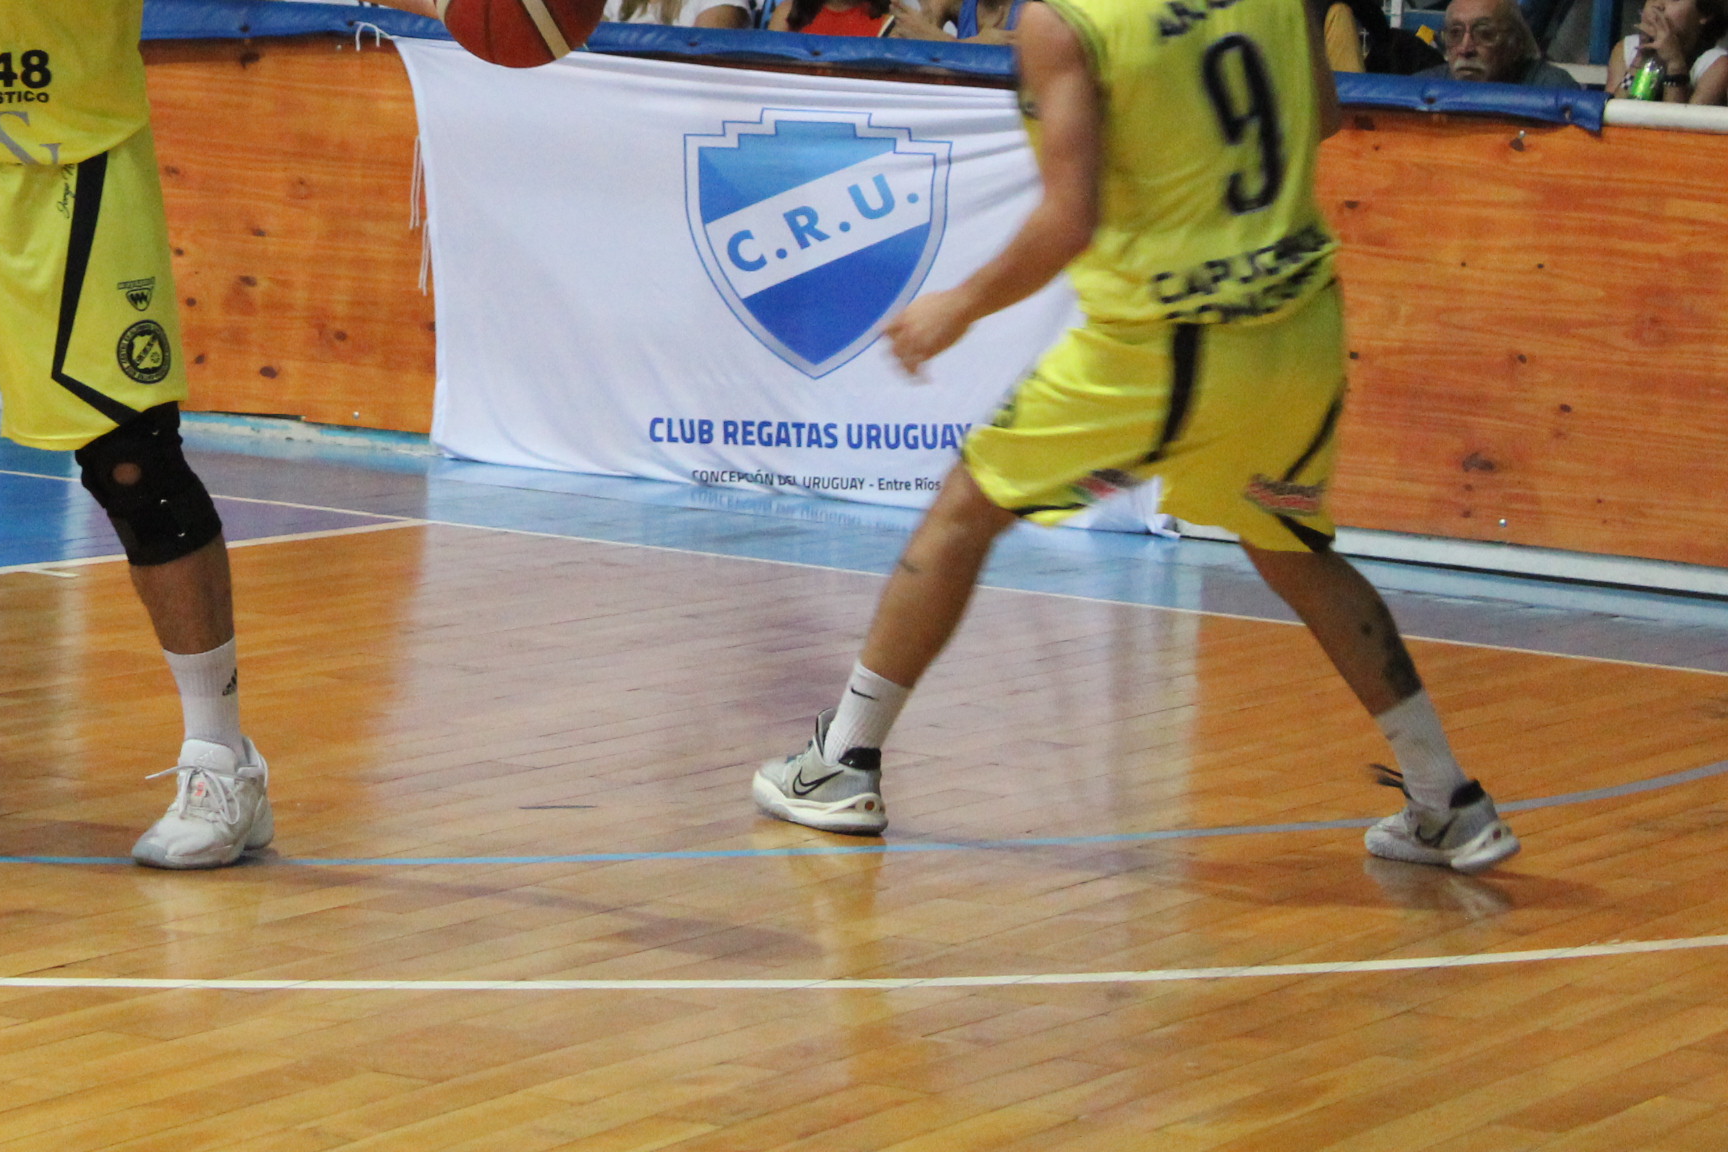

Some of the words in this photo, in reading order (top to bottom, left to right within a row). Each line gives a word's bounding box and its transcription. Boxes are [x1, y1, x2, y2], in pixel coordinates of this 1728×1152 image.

[1202, 32, 1284, 216] 9
[726, 173, 920, 272] C.R.U.
[649, 417, 714, 445] CLUB
[723, 420, 839, 448] REGATAS
[692, 469, 773, 486] CONCEPCIÓN
[802, 477, 864, 490] URUGUAY
[878, 477, 911, 491] Entre
[915, 476, 941, 491] Ríos
